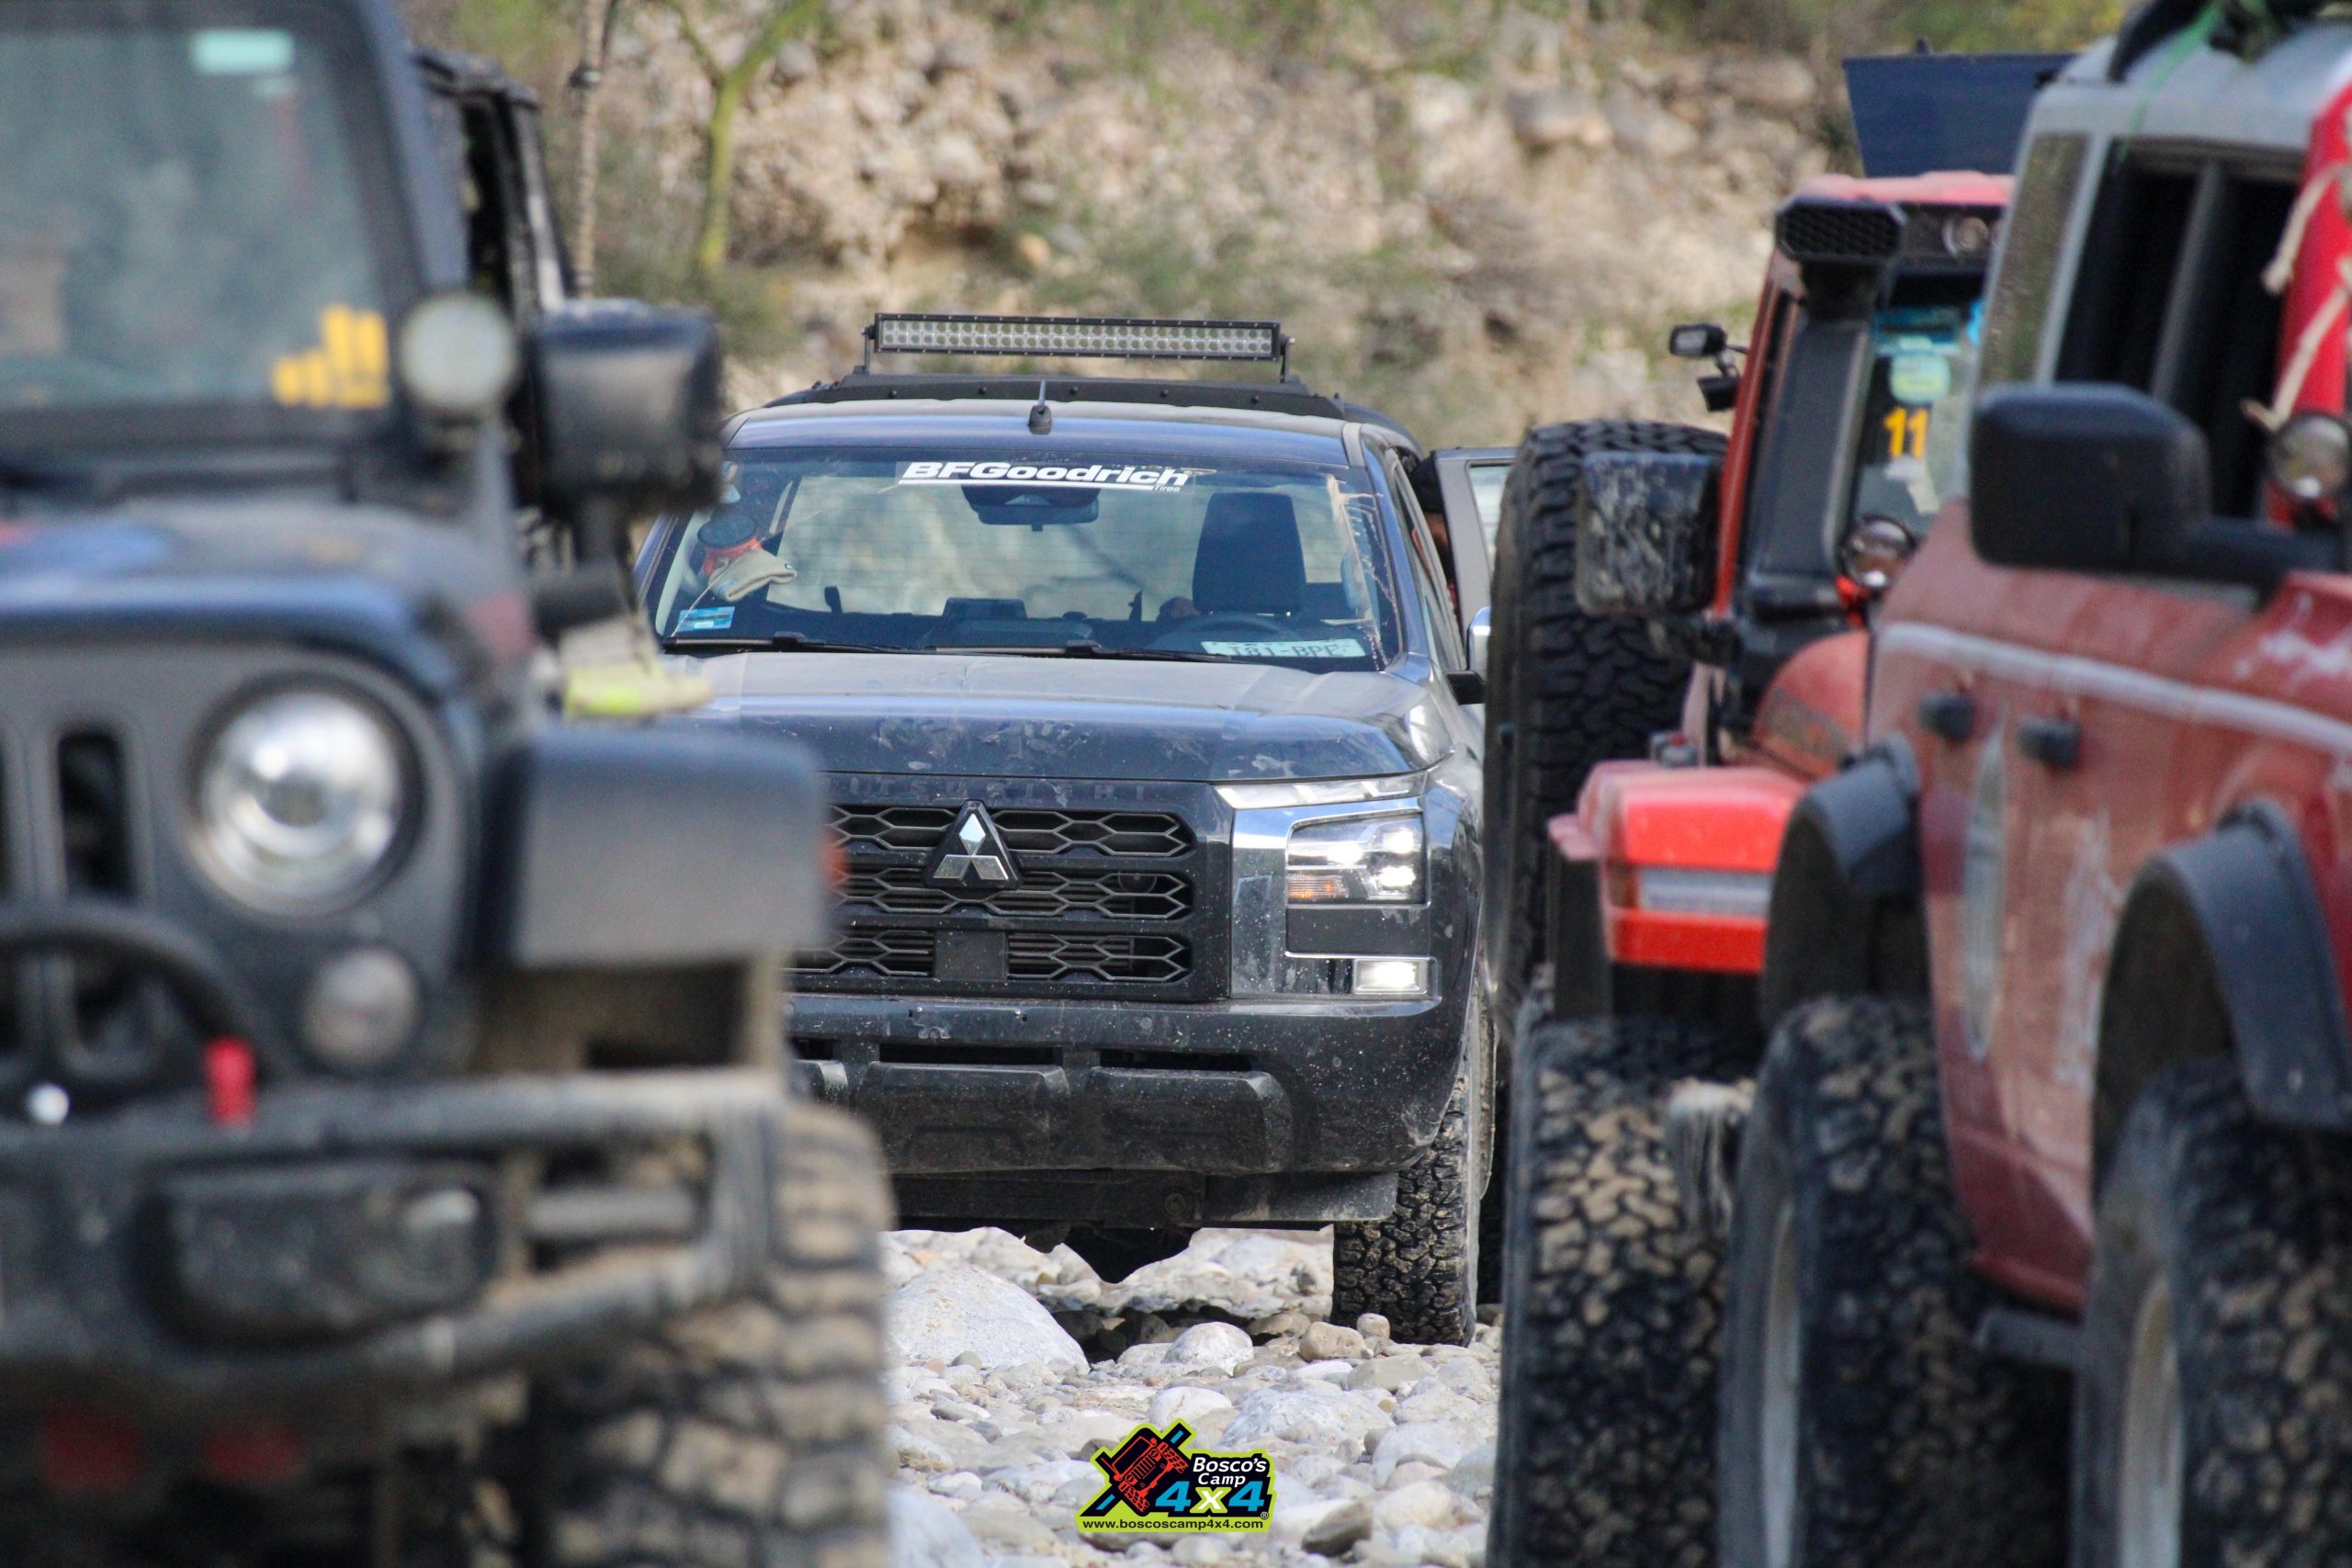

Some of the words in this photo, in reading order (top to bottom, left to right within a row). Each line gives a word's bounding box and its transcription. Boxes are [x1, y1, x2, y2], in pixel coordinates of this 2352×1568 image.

[1883, 406, 1928, 459] 11
[901, 461, 1189, 486] BFGoodrich
[1154, 484, 1182, 492] Tires
